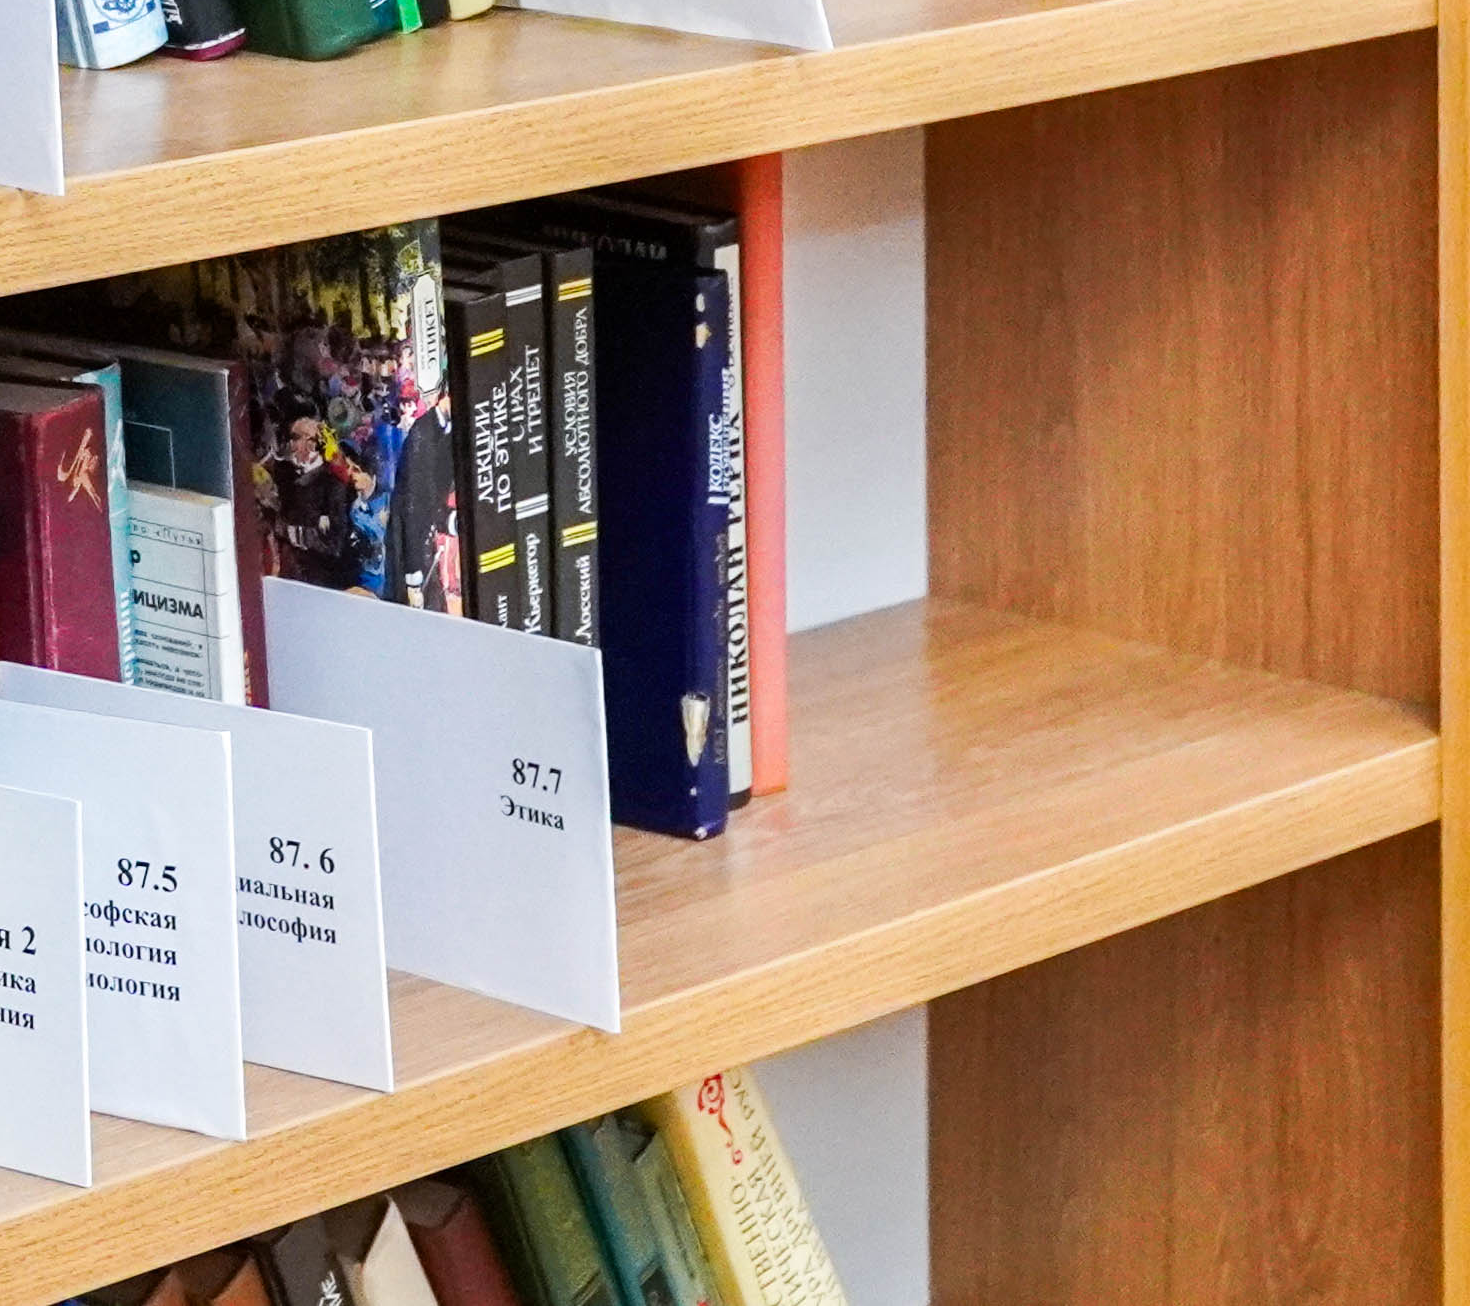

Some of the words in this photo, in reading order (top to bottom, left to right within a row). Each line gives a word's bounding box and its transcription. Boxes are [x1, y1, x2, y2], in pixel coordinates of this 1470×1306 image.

[425, 296, 439, 374] ЭТИКЕТ
[572, 307, 589, 365] ДОБРА
[492, 384, 509, 468] ЭТИКЕ
[523, 345, 542, 429] ТРЕПЕТ
[562, 373, 580, 451] УСЛОВИЯ
[476, 398, 494, 504] ЛЕКЦИИ
[573, 371, 594, 515] АБСОЛЮТНОГО
[706, 412, 726, 493] КОДЕКС
[495, 474, 514, 513] ПО
[523, 532, 542, 635] Кьеркегор
[500, 796, 565, 830] Этика
[511, 757, 563, 796] 87.7
[117, 858, 178, 892] 87.5
[269, 836, 310, 870] 87.
[21, 927, 37, 956] 2
